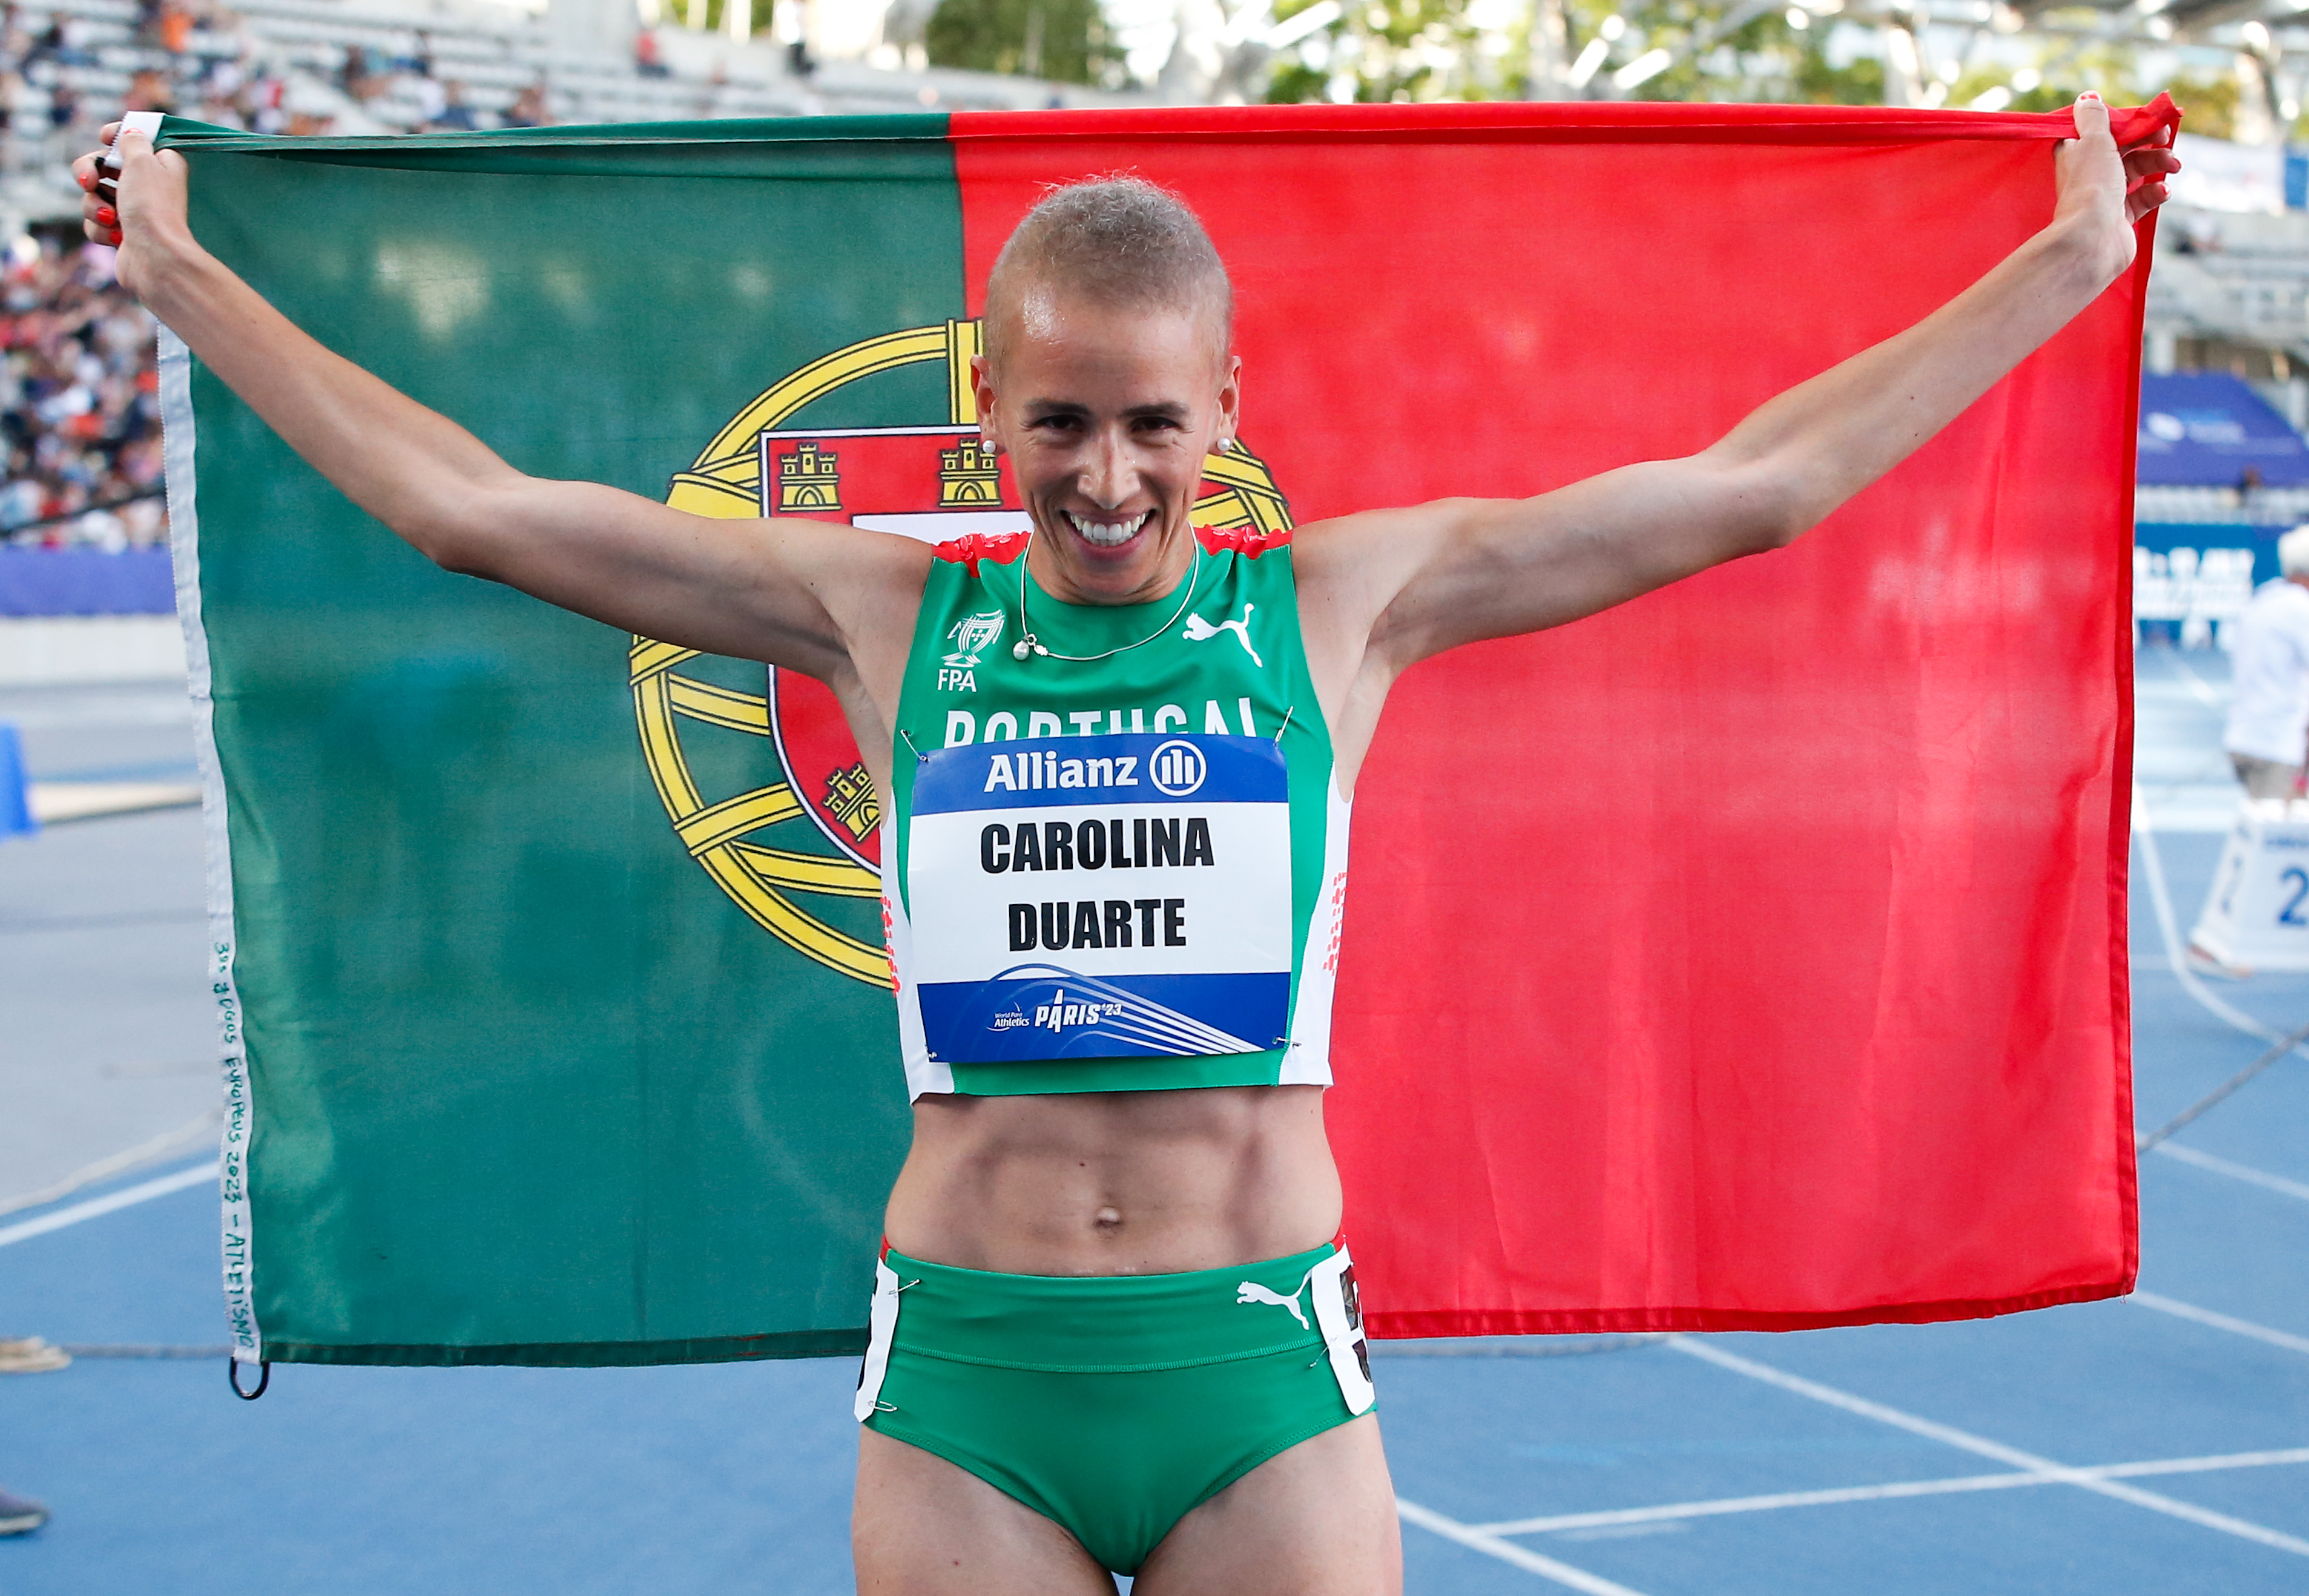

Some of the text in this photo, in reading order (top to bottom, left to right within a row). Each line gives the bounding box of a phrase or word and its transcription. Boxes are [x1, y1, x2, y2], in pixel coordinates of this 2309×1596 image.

[938, 669, 977, 692] FPA
[984, 750, 1139, 792] Allianz
[981, 818, 1214, 874] CAROLINA
[1008, 899, 1187, 951] DUARTE
[994, 1017, 1030, 1028] Athletics
[1034, 990, 1101, 1033] PARIS
[225, 1152, 242, 1203] 2023
